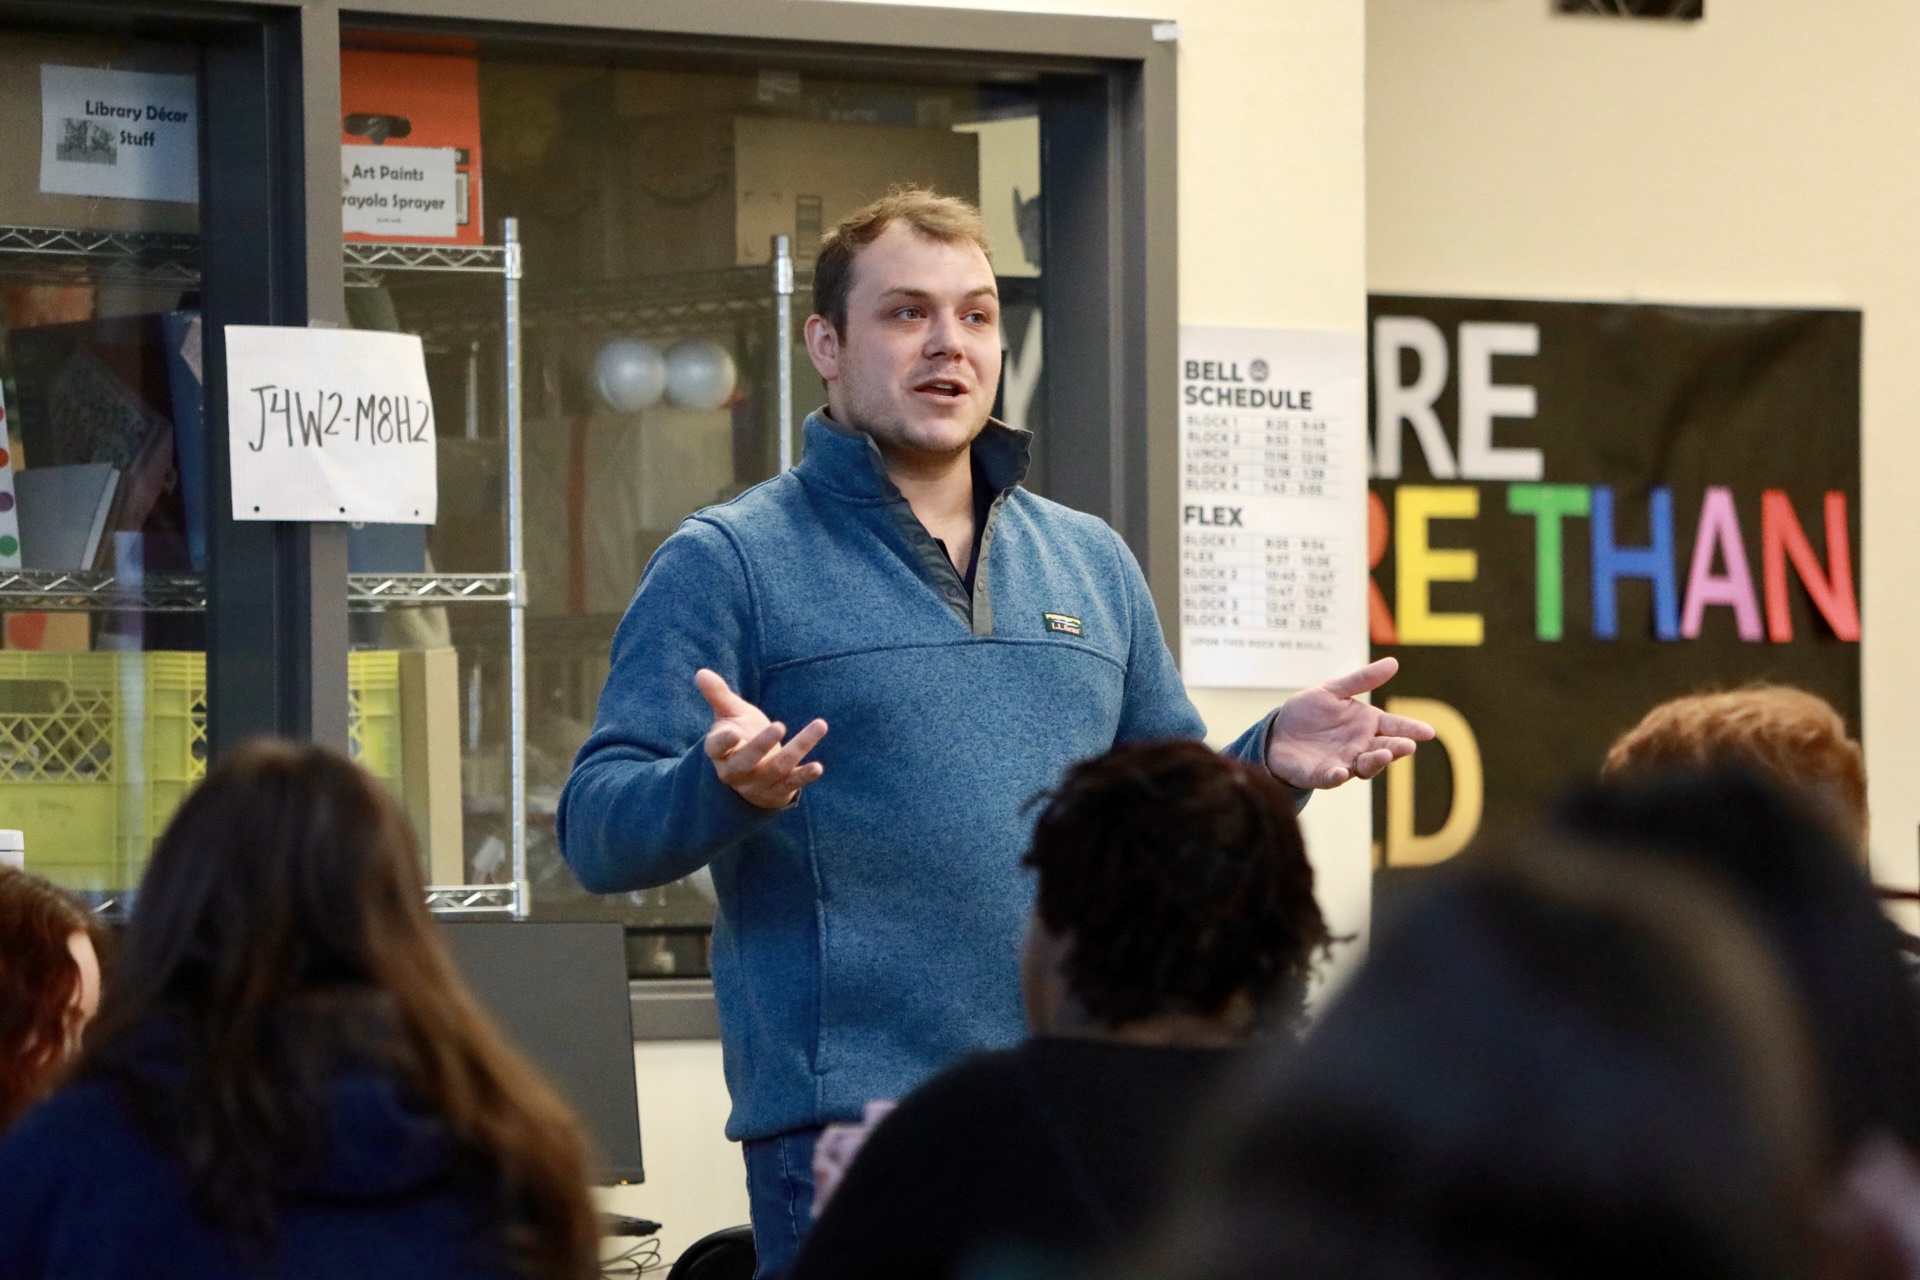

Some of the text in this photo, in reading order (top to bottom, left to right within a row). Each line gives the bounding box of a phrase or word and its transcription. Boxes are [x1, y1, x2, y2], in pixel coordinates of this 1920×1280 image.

[85, 100, 189, 123] Library Décor
[119, 130, 155, 147] Stuff
[352, 164, 424, 181] Art Paints
[392, 194, 445, 212] Sprayer
[1186, 360, 1243, 382] BELL
[1185, 386, 1312, 410] SCHEDULE
[1368, 314, 1545, 480] RE
[249, 385, 429, 452] J4W2-M8H2
[1184, 506, 1243, 526] FLEX
[1507, 484, 1861, 642] THAN
